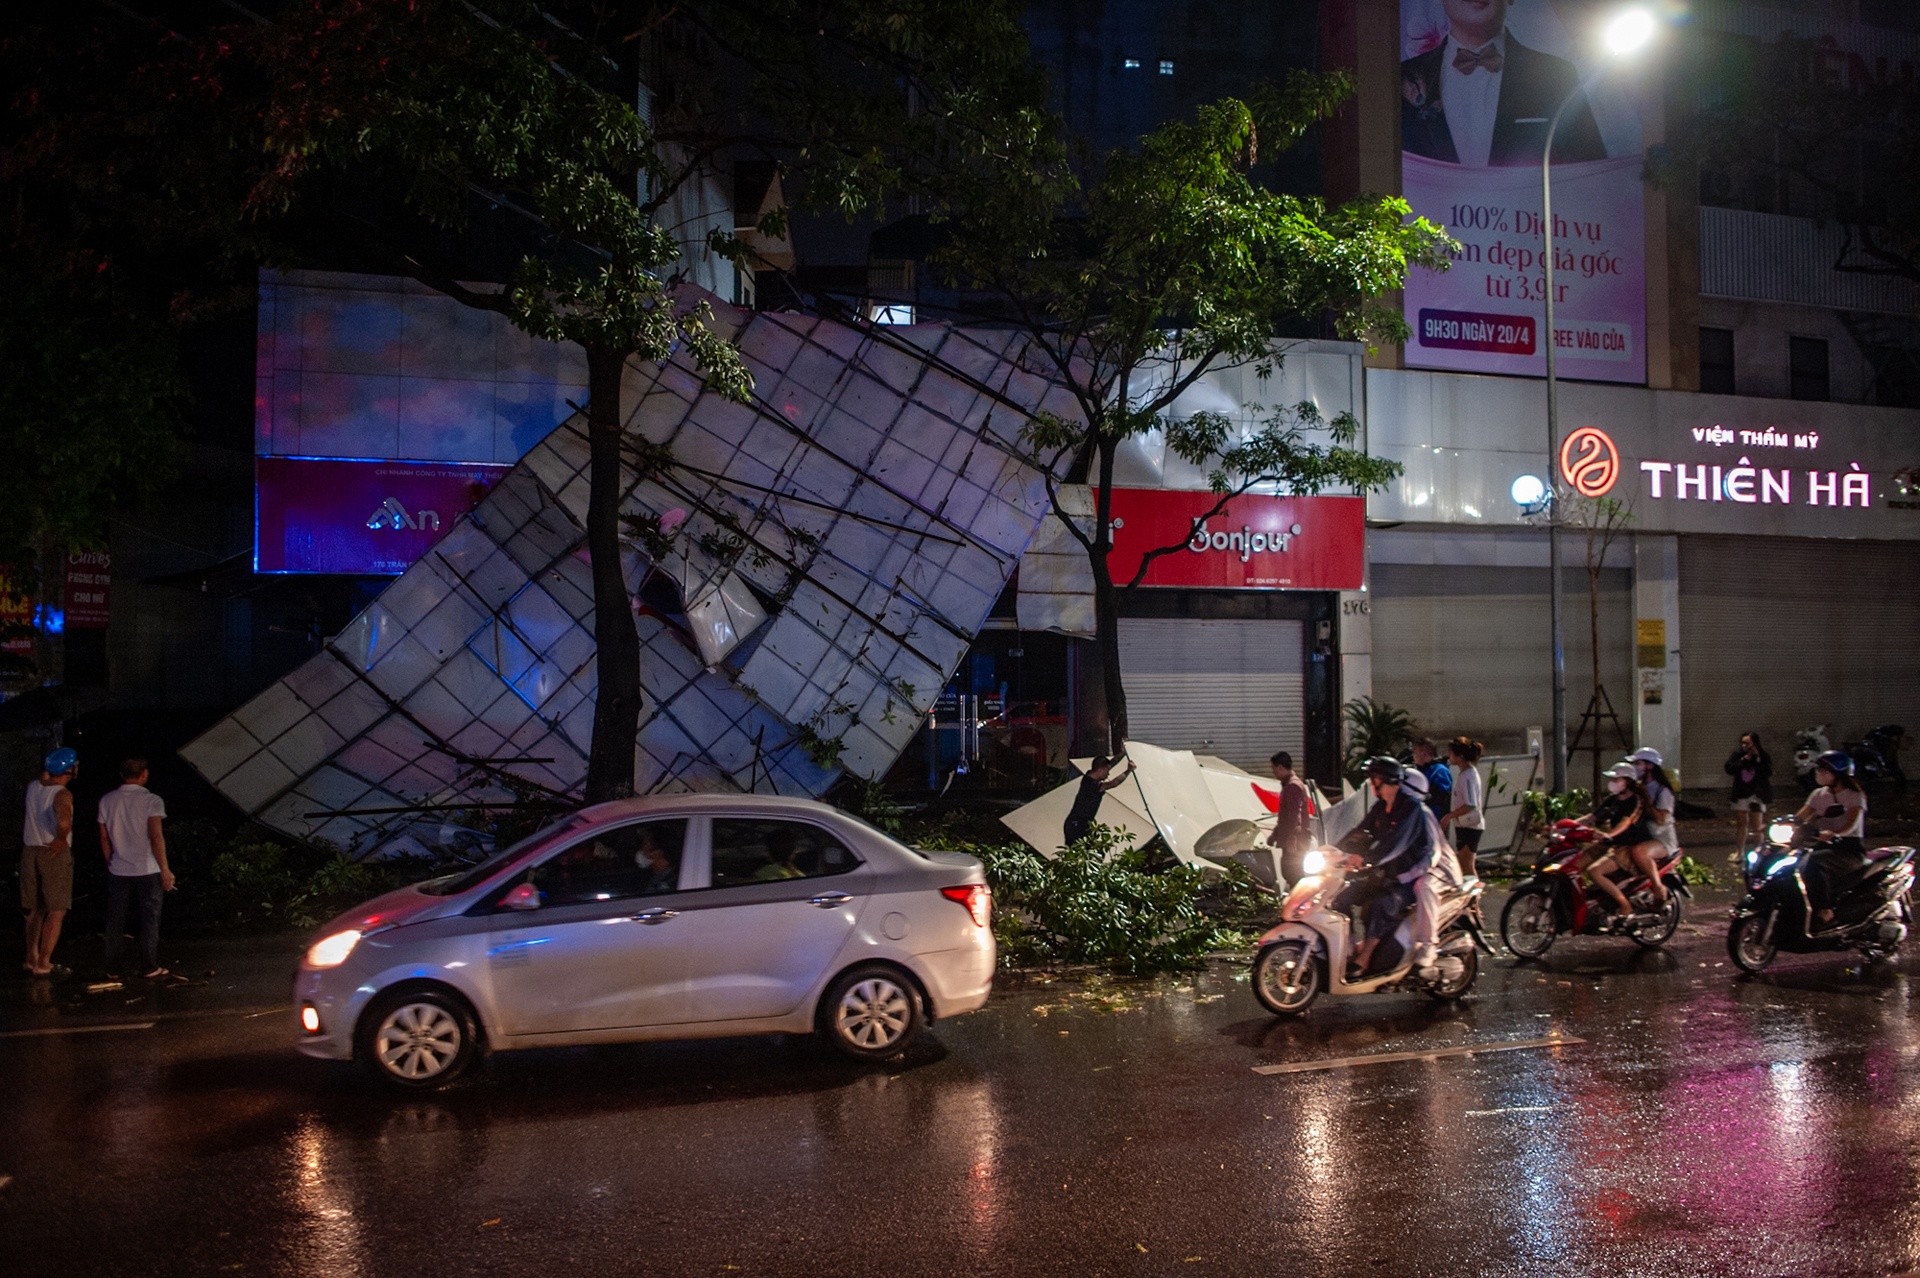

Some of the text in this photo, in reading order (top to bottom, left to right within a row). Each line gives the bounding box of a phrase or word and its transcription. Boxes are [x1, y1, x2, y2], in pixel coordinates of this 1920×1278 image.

[1450, 204, 1508, 232] 100%
[1573, 221, 1601, 245] vụ
[1581, 250, 1624, 279] gốc
[1486, 274, 1512, 299] từ
[1425, 318, 1626, 352] 9H30 NGÀY 20/4 REE VÀO CỬA
[1692, 425, 1820, 450] VIỆN THẨM MỸ
[1639, 455, 1872, 509] THIÊN HÀ
[1187, 516, 1292, 562] Bonjour
[1343, 600, 1370, 615] 176
